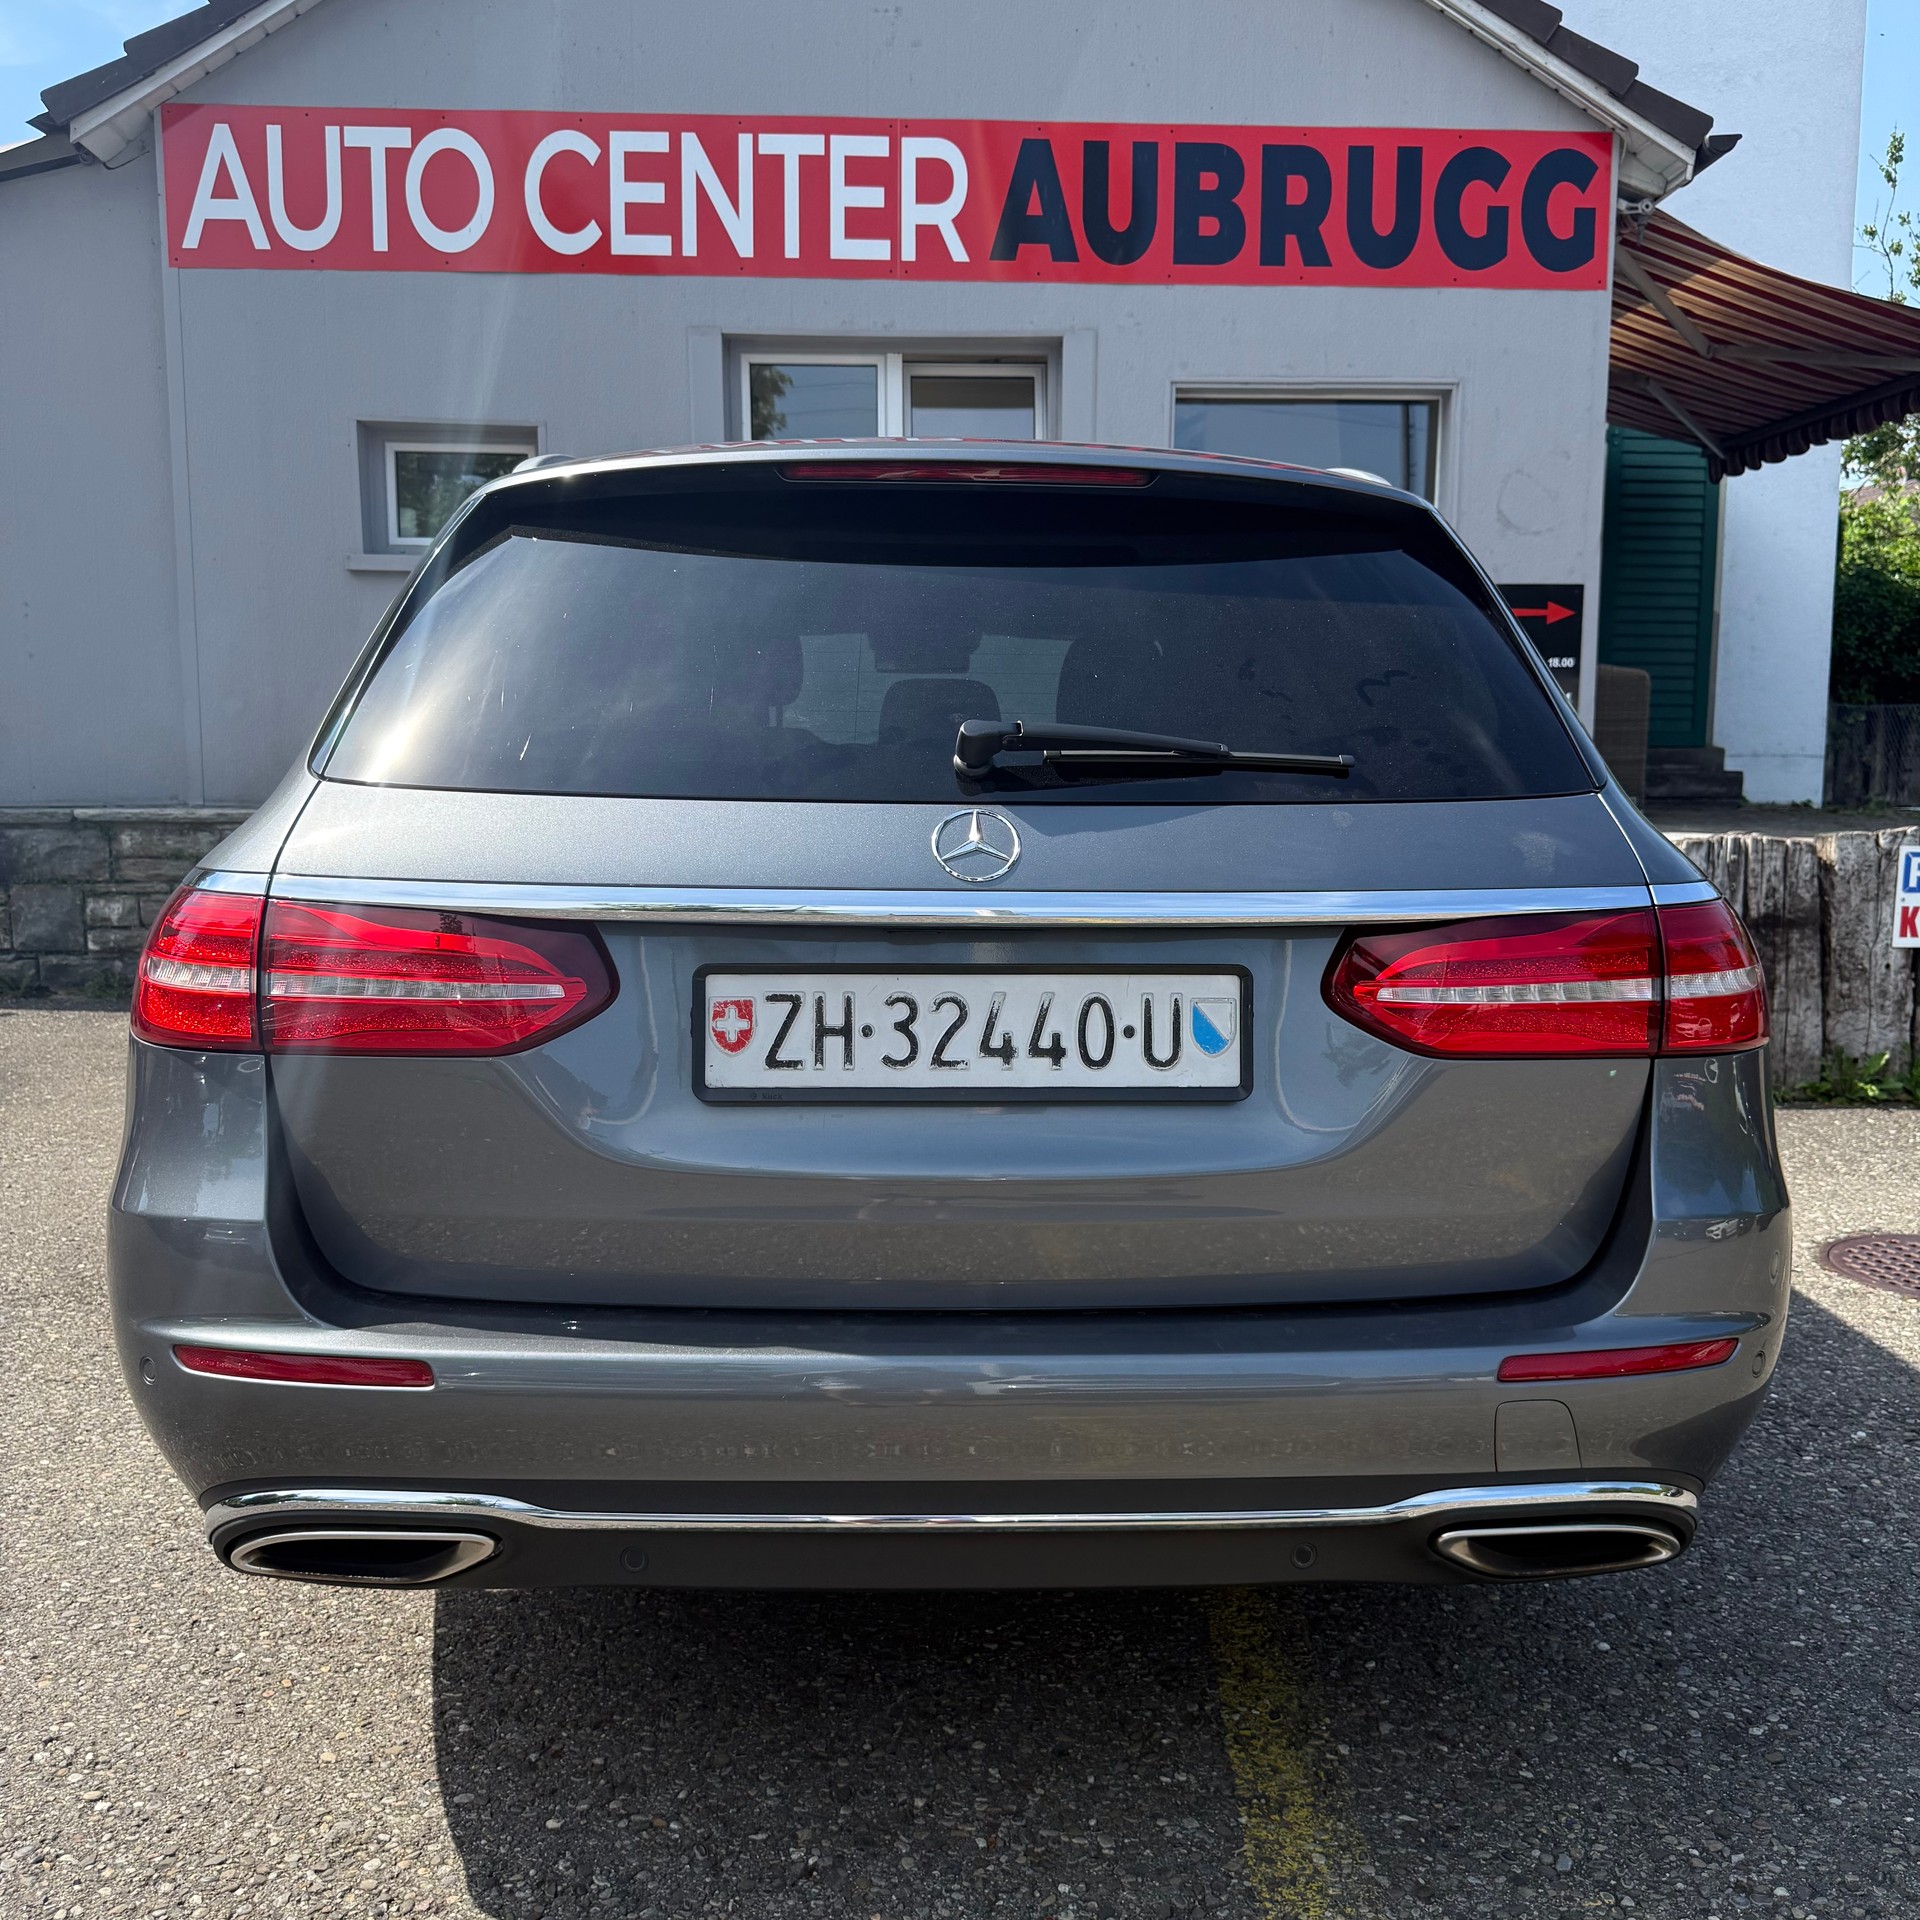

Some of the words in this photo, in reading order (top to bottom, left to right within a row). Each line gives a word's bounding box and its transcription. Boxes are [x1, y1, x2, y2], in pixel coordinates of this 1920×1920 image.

[181, 123, 495, 254] AUTO
[524, 129, 971, 263] CENTER
[990, 137, 1600, 273] AUBRUGG
[1547, 656, 1575, 668] 18.00
